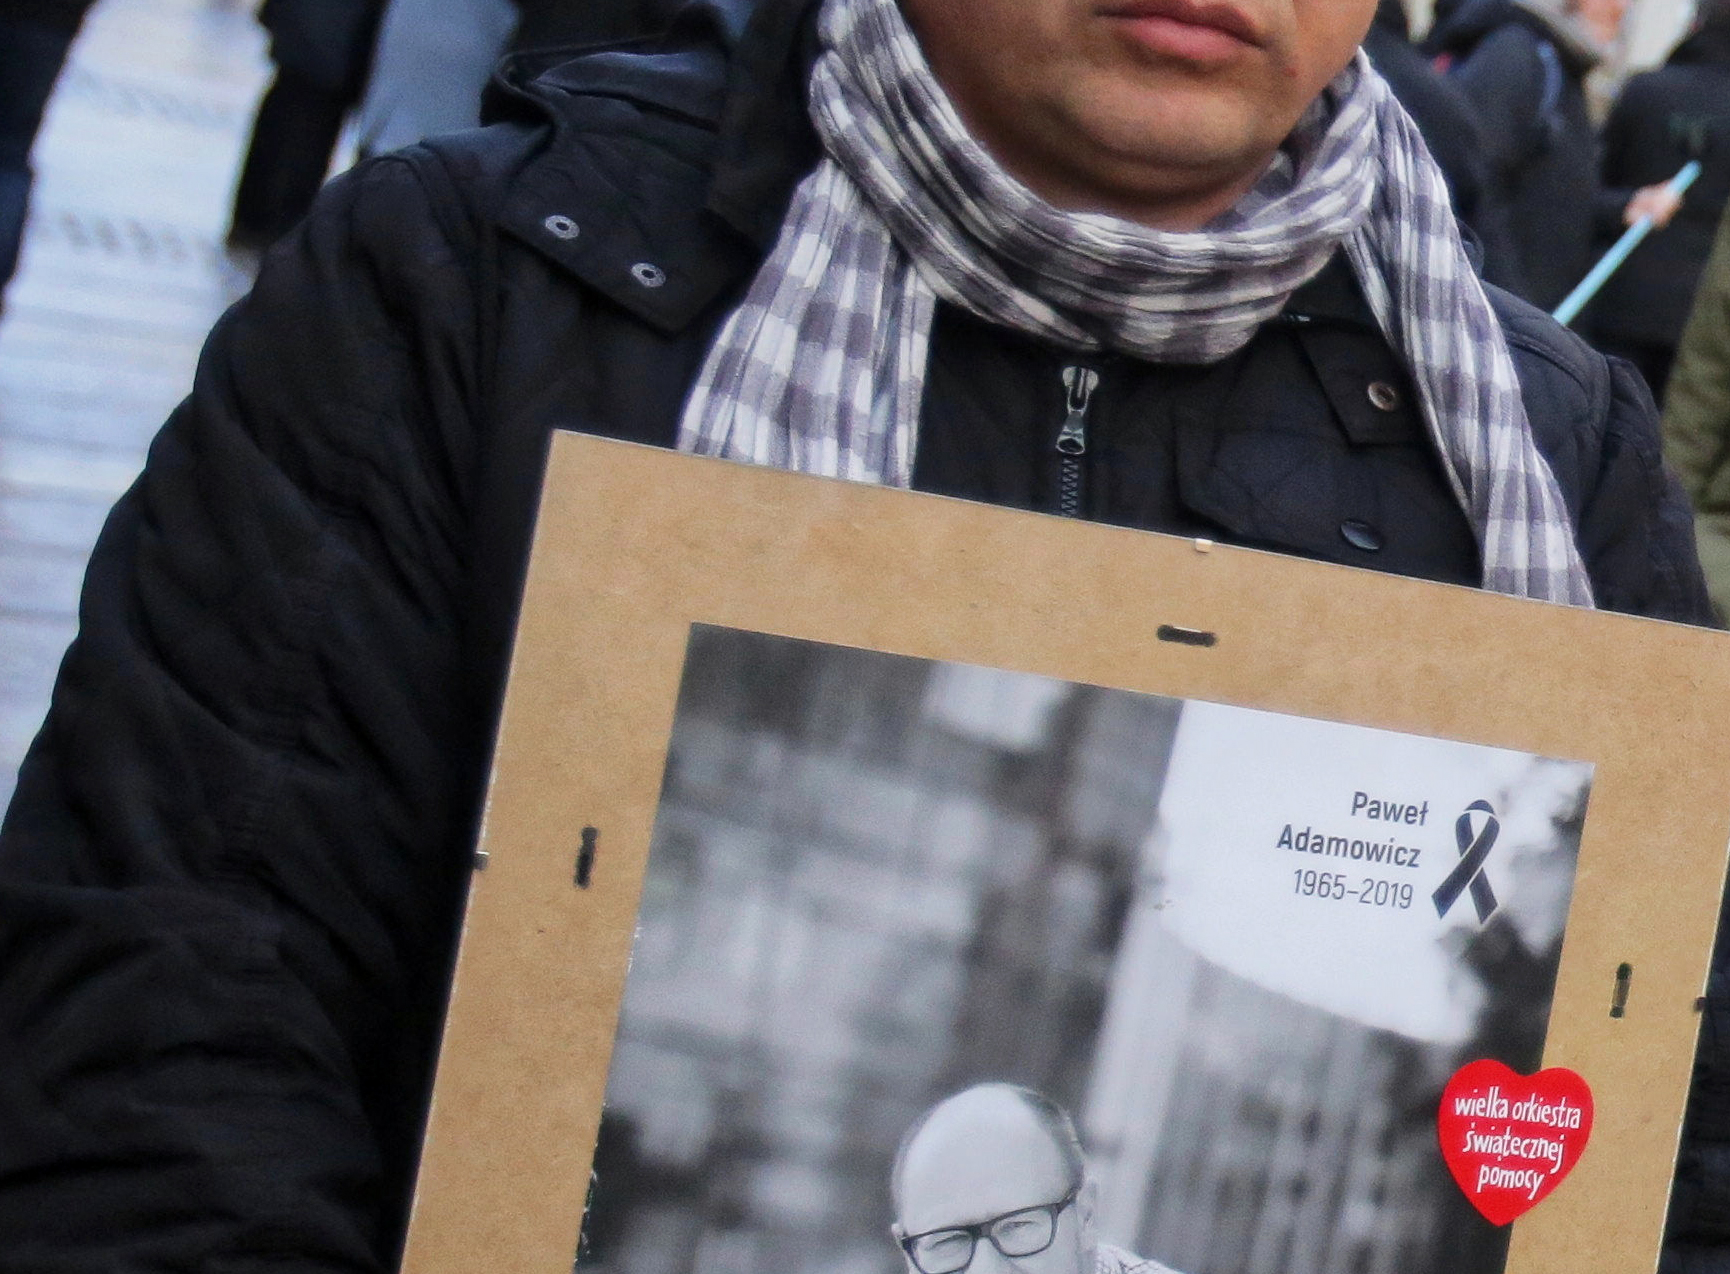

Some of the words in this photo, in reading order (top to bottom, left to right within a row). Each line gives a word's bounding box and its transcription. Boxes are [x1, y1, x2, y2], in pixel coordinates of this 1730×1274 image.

[1351, 791, 1429, 826] Paweł
[1277, 824, 1421, 867] Adamowicz
[1455, 1086, 1508, 1119] wielka
[1512, 1093, 1581, 1128] orkiestra
[1463, 1122, 1564, 1174] świątecznej
[1477, 1164, 1544, 1200] pomocy
